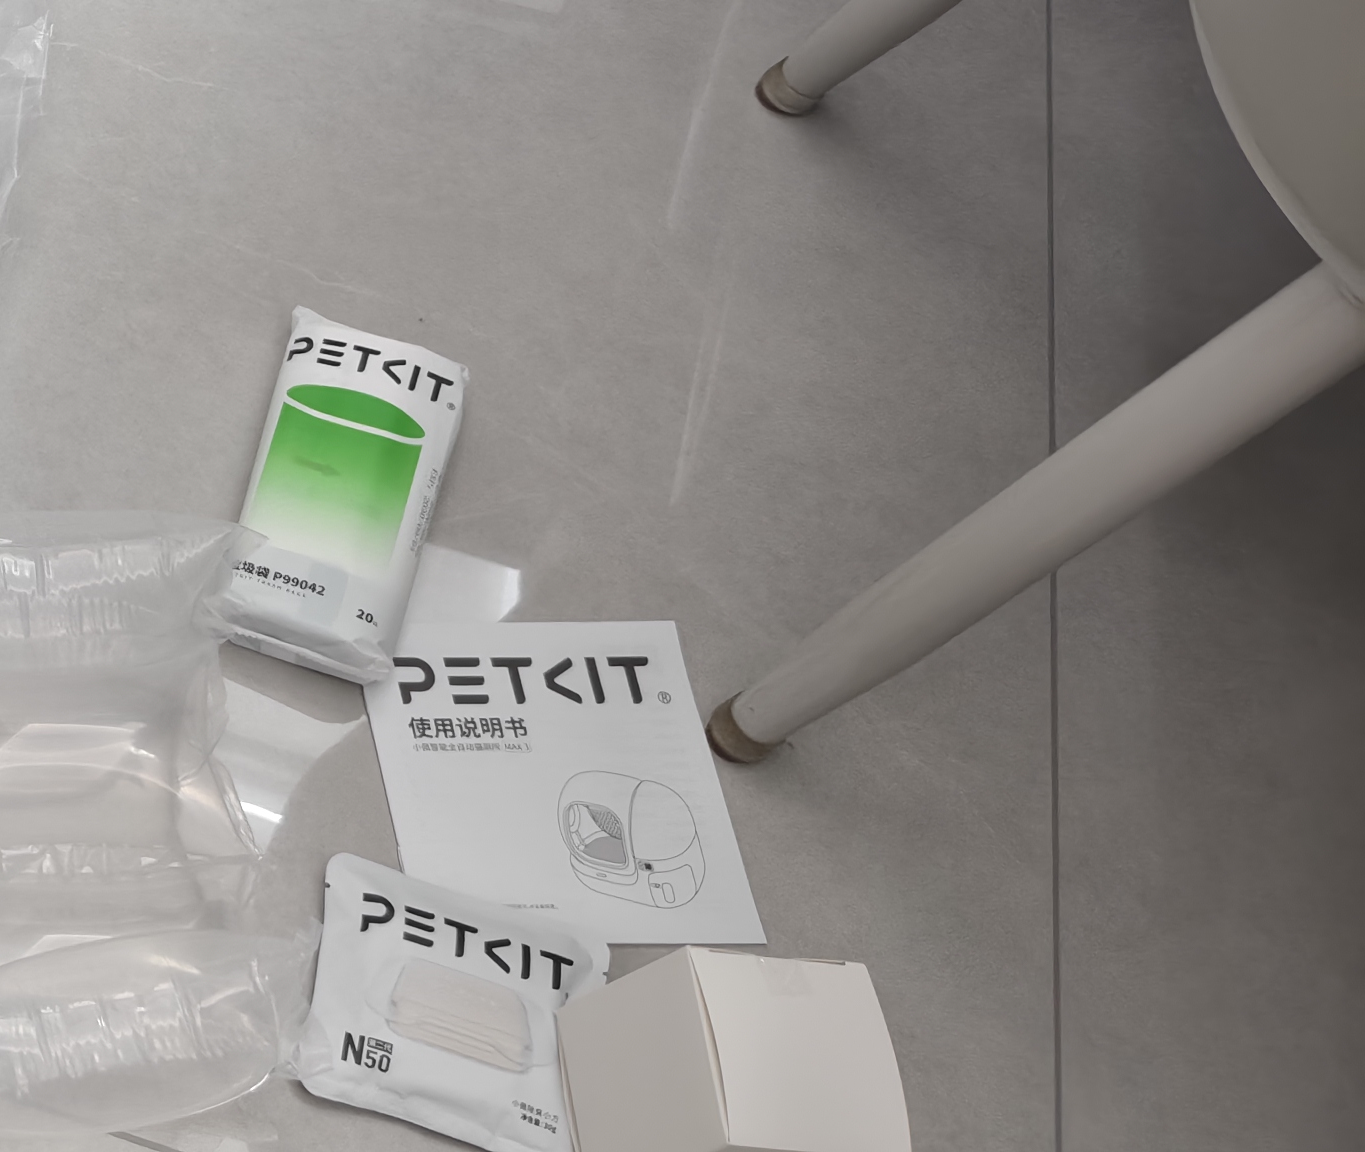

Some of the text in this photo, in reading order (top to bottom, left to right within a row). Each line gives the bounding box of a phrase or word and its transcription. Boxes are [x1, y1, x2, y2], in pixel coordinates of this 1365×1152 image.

[285, 336, 454, 403] PETKIT
[272, 571, 327, 596] P99042
[392, 656, 648, 705] PETKIT
[408, 716, 529, 740] 使用说明书
[360, 892, 574, 990] PETKIT
